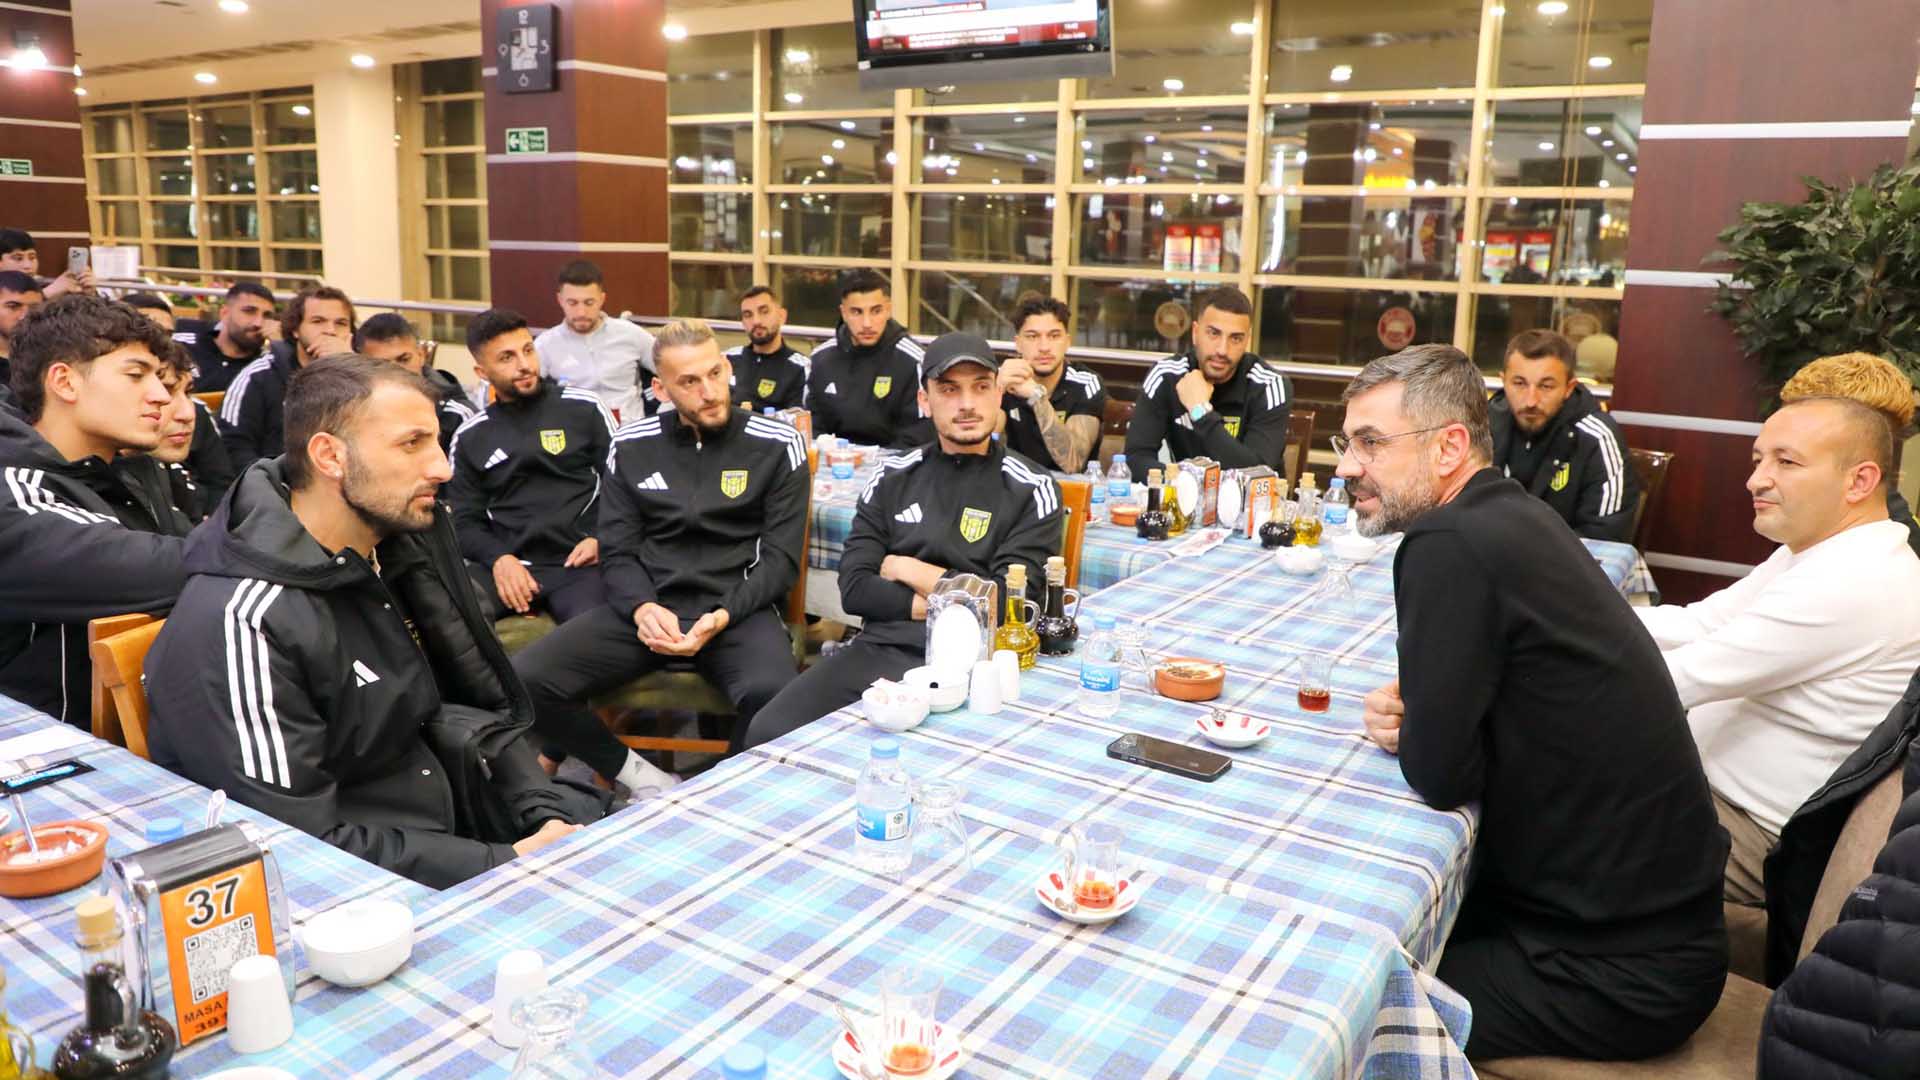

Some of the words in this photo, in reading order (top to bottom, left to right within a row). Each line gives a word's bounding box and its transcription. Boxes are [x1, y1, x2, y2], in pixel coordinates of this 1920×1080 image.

[539, 39, 550, 54] 3
[518, 73, 529, 88] 6
[1256, 480, 1270, 495] 35
[187, 876, 240, 926] 37
[184, 1001, 223, 1024] MASA
